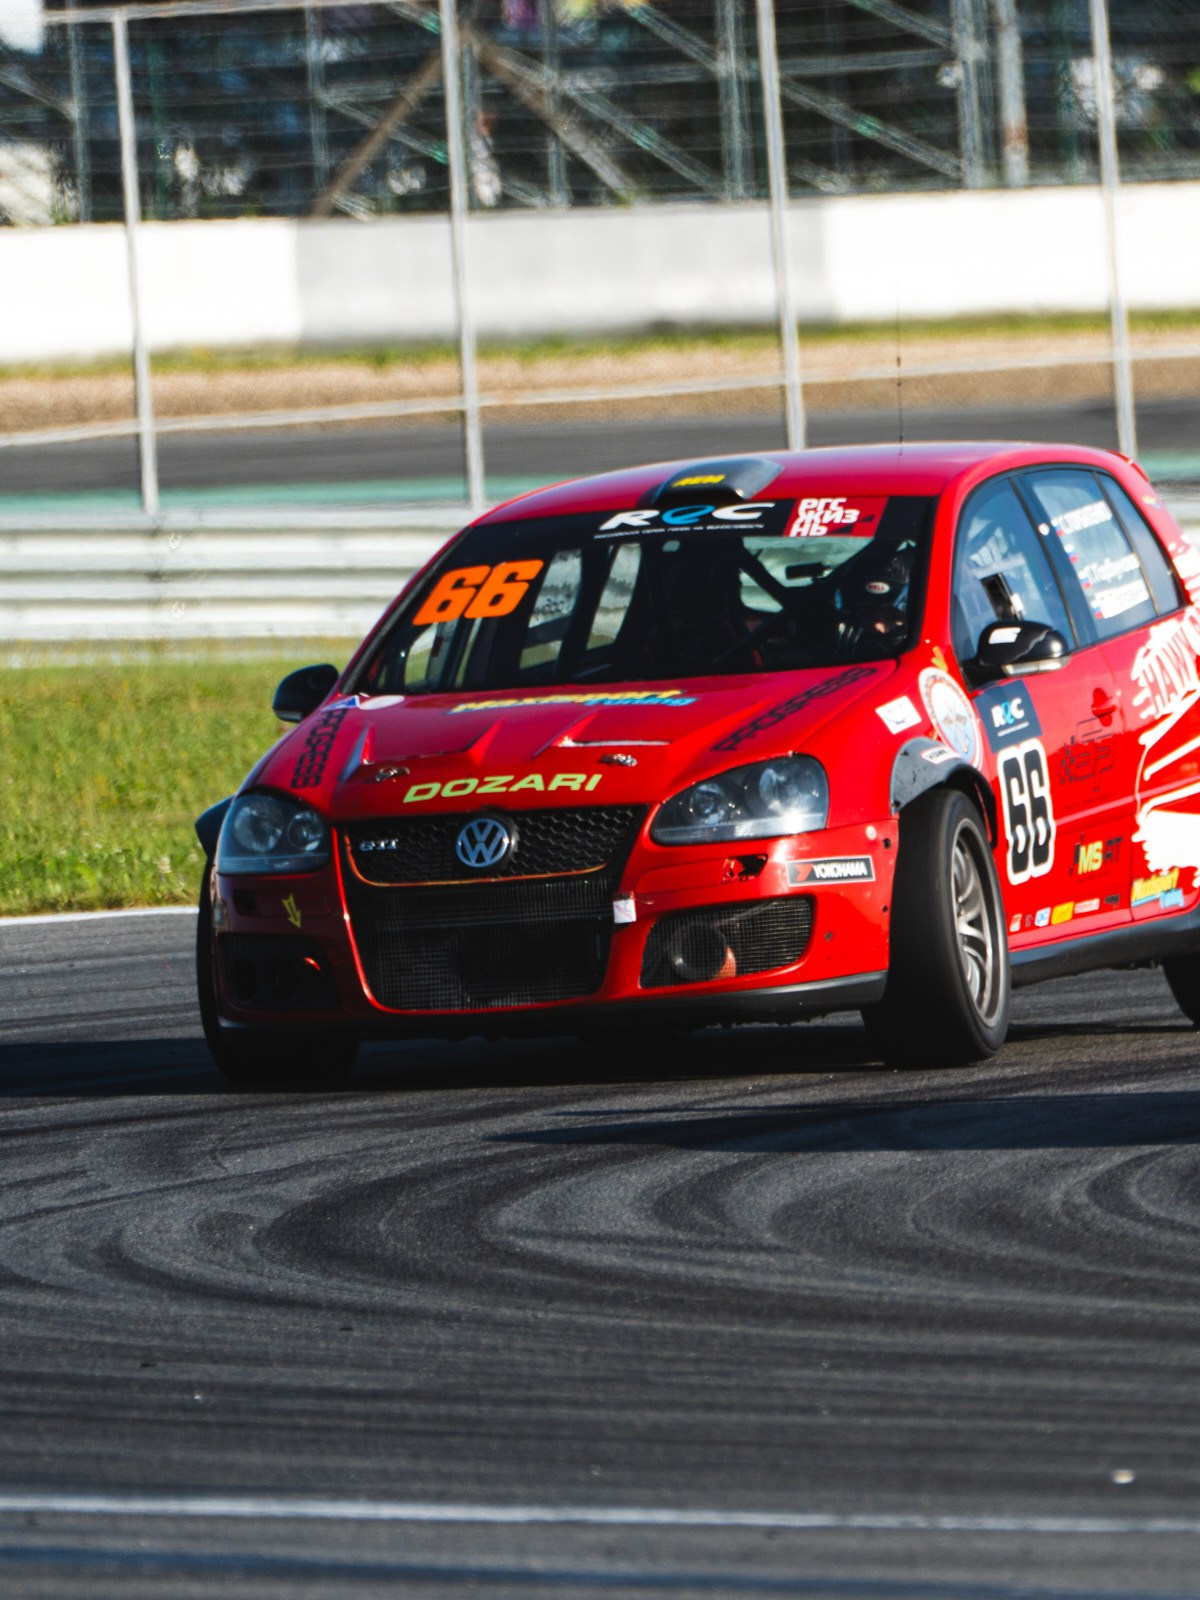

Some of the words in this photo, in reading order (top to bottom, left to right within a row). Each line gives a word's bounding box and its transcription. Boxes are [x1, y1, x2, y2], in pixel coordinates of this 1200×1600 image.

[798, 497, 847, 511] РГС
[795, 509, 860, 524] ЖИЗ
[789, 521, 828, 537] НЬ
[413, 559, 543, 626] 66
[403, 773, 602, 803] DOZARI
[1001, 745, 1052, 876] 66
[812, 861, 868, 878] YOKOHAMA
